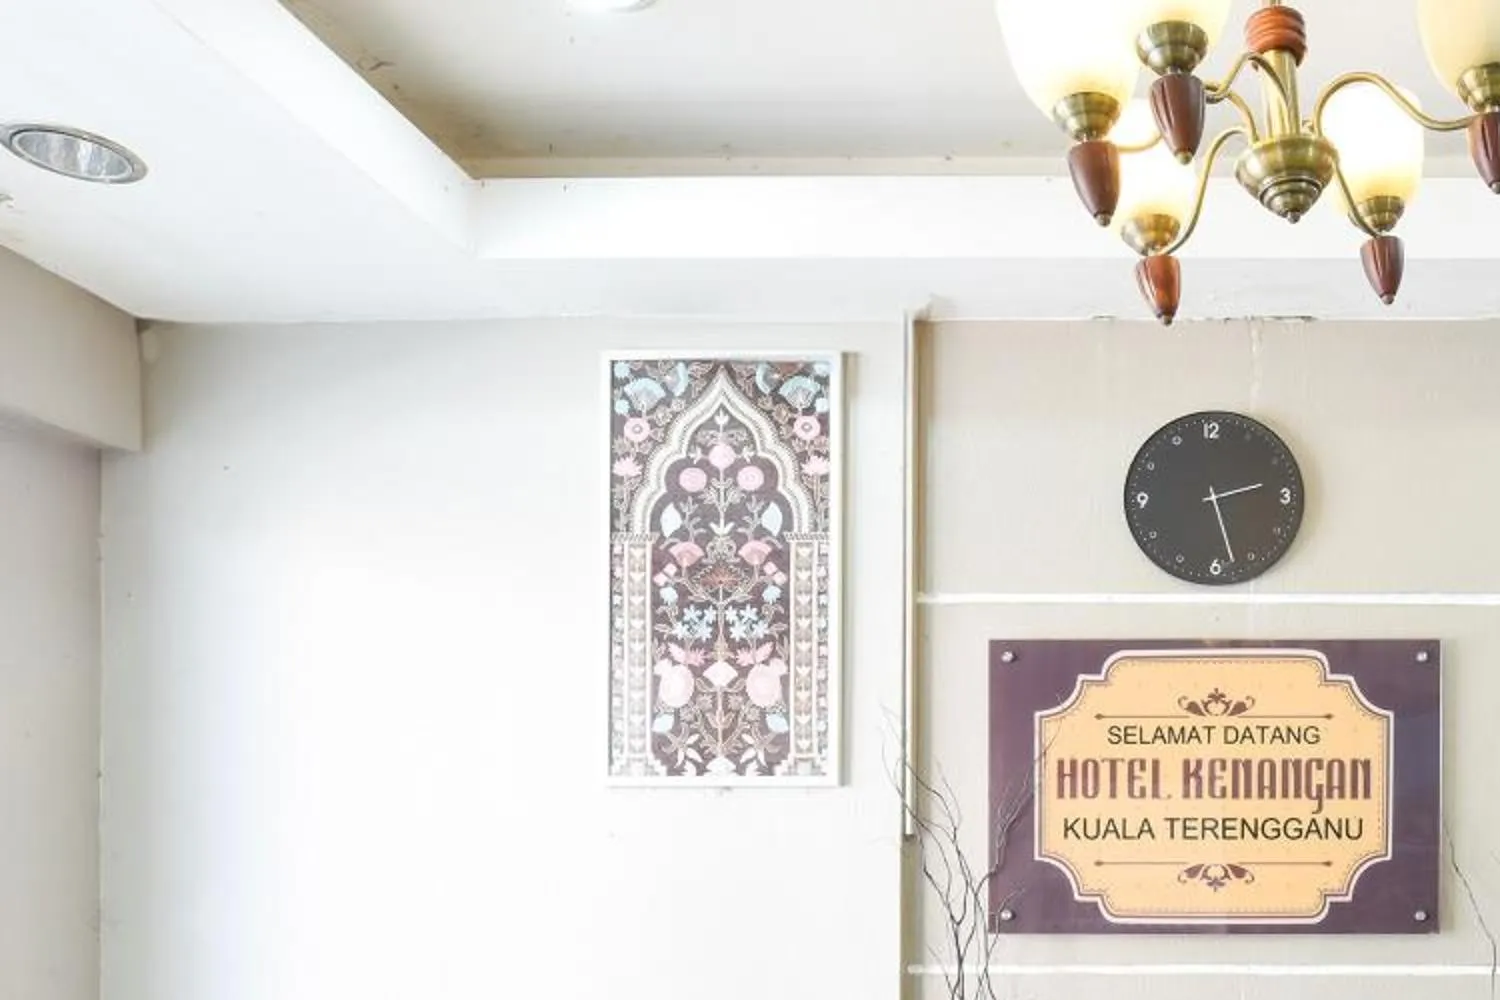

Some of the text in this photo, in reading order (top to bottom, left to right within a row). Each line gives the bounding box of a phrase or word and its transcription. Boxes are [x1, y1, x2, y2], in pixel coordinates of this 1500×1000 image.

[1203, 422, 1220, 439] 12
[1136, 491, 1149, 508] 9
[1279, 487, 1291, 505] 3
[1209, 558, 1221, 575] 6
[1107, 725, 1321, 745] SELAMAT DATANG
[1056, 757, 1372, 815] HOTEL KENANGAN
[1063, 817, 1364, 841] KUALA TERENGGANU
